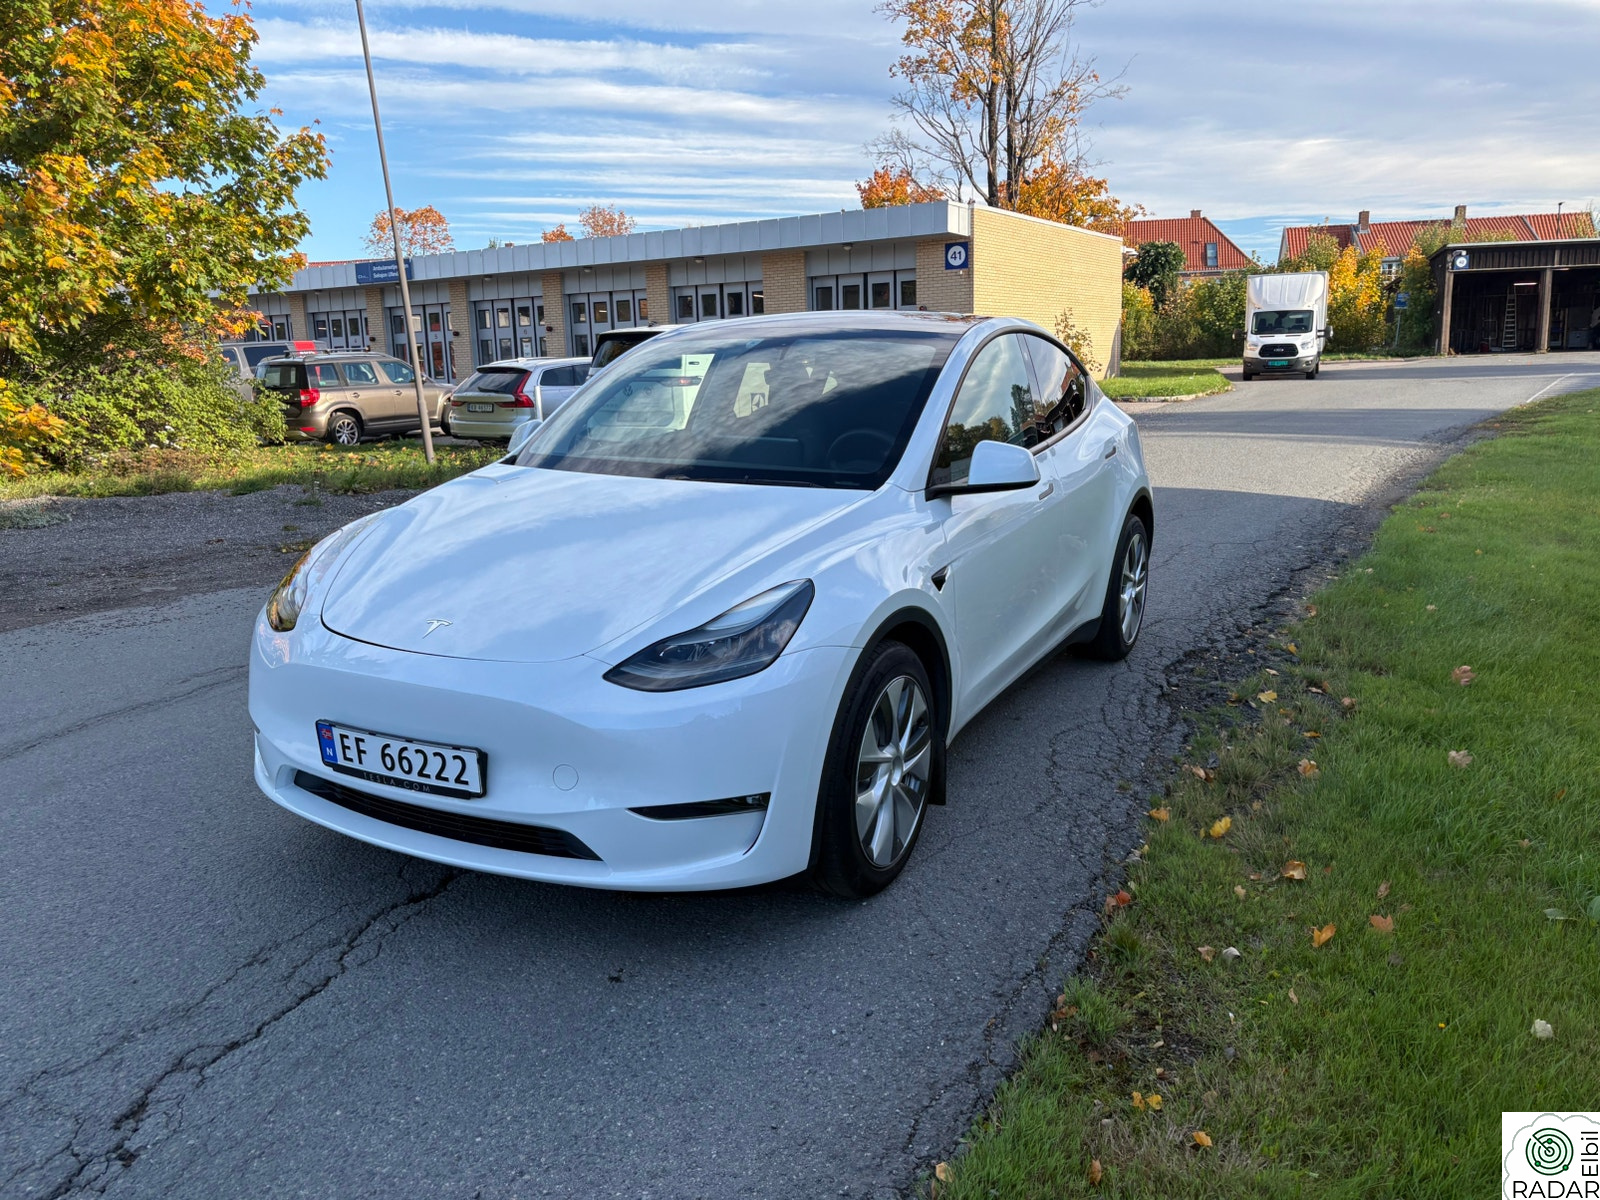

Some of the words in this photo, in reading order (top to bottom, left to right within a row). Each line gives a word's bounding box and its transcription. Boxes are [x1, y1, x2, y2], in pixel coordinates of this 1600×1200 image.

[950, 250, 962, 261] 41
[326, 747, 334, 757] N
[339, 733, 367, 765] EF
[381, 743, 469, 786] 66222
[363, 771, 431, 792] TESLA.COM
